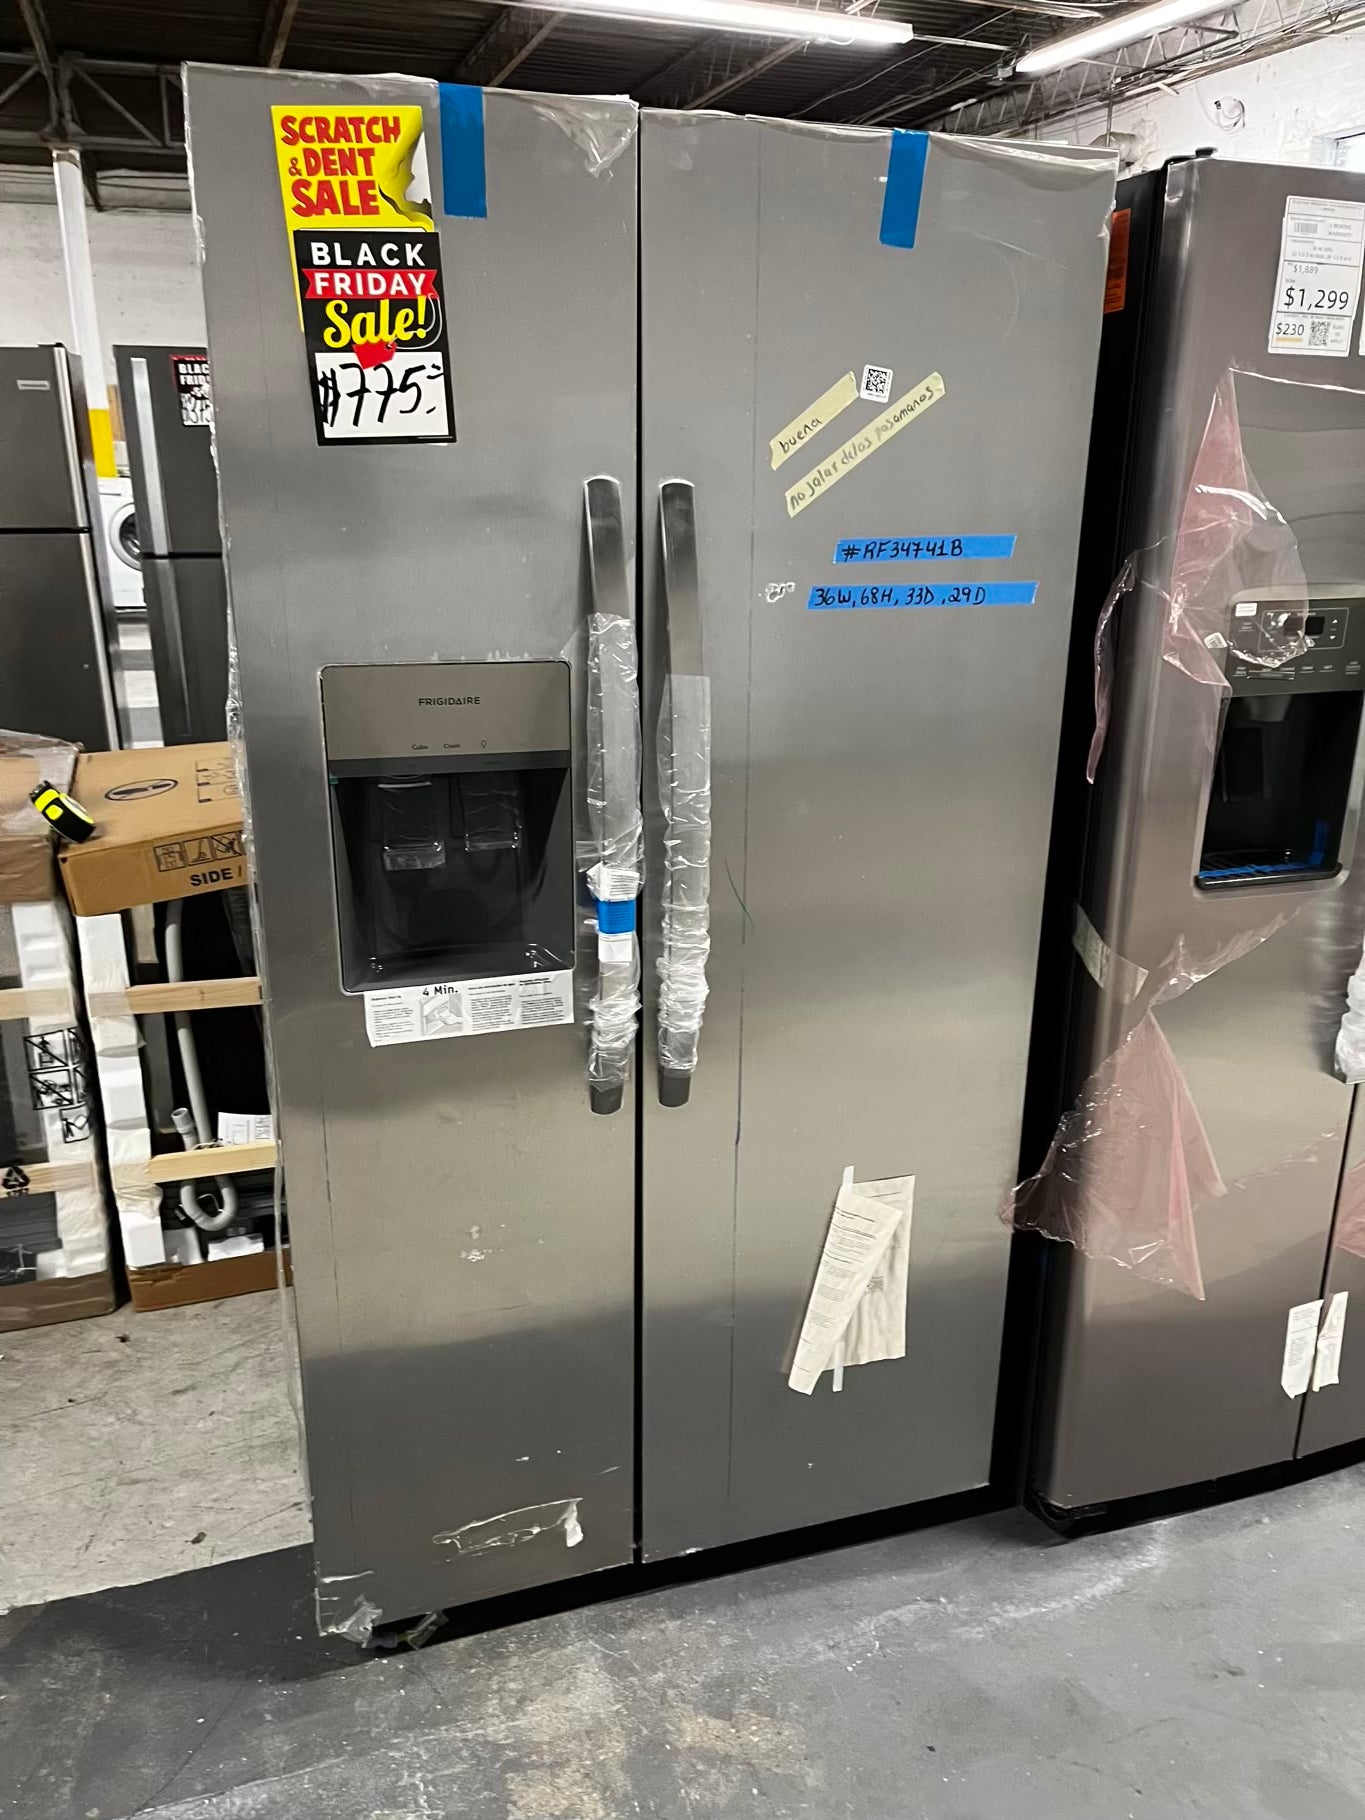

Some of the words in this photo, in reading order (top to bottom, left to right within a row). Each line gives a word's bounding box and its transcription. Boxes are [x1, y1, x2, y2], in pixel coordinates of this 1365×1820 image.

[280, 115, 401, 146] SCRATCH
[288, 157, 302, 176] &
[303, 147, 375, 177] DENT
[291, 178, 380, 218] SALE
[310, 242, 426, 267] BLACK
[313, 271, 427, 296] FRIDAY
[1283, 285, 1349, 311] $1,299
[323, 294, 428, 348] Sale!
[1275, 322, 1305, 336] $230
[178, 363, 210, 374] BLAC
[778, 417, 823, 454] buena
[418, 696, 481, 706] FRIGIDAIRE
[190, 867, 234, 887] SIDE
[434, 984, 459, 996] Min.
